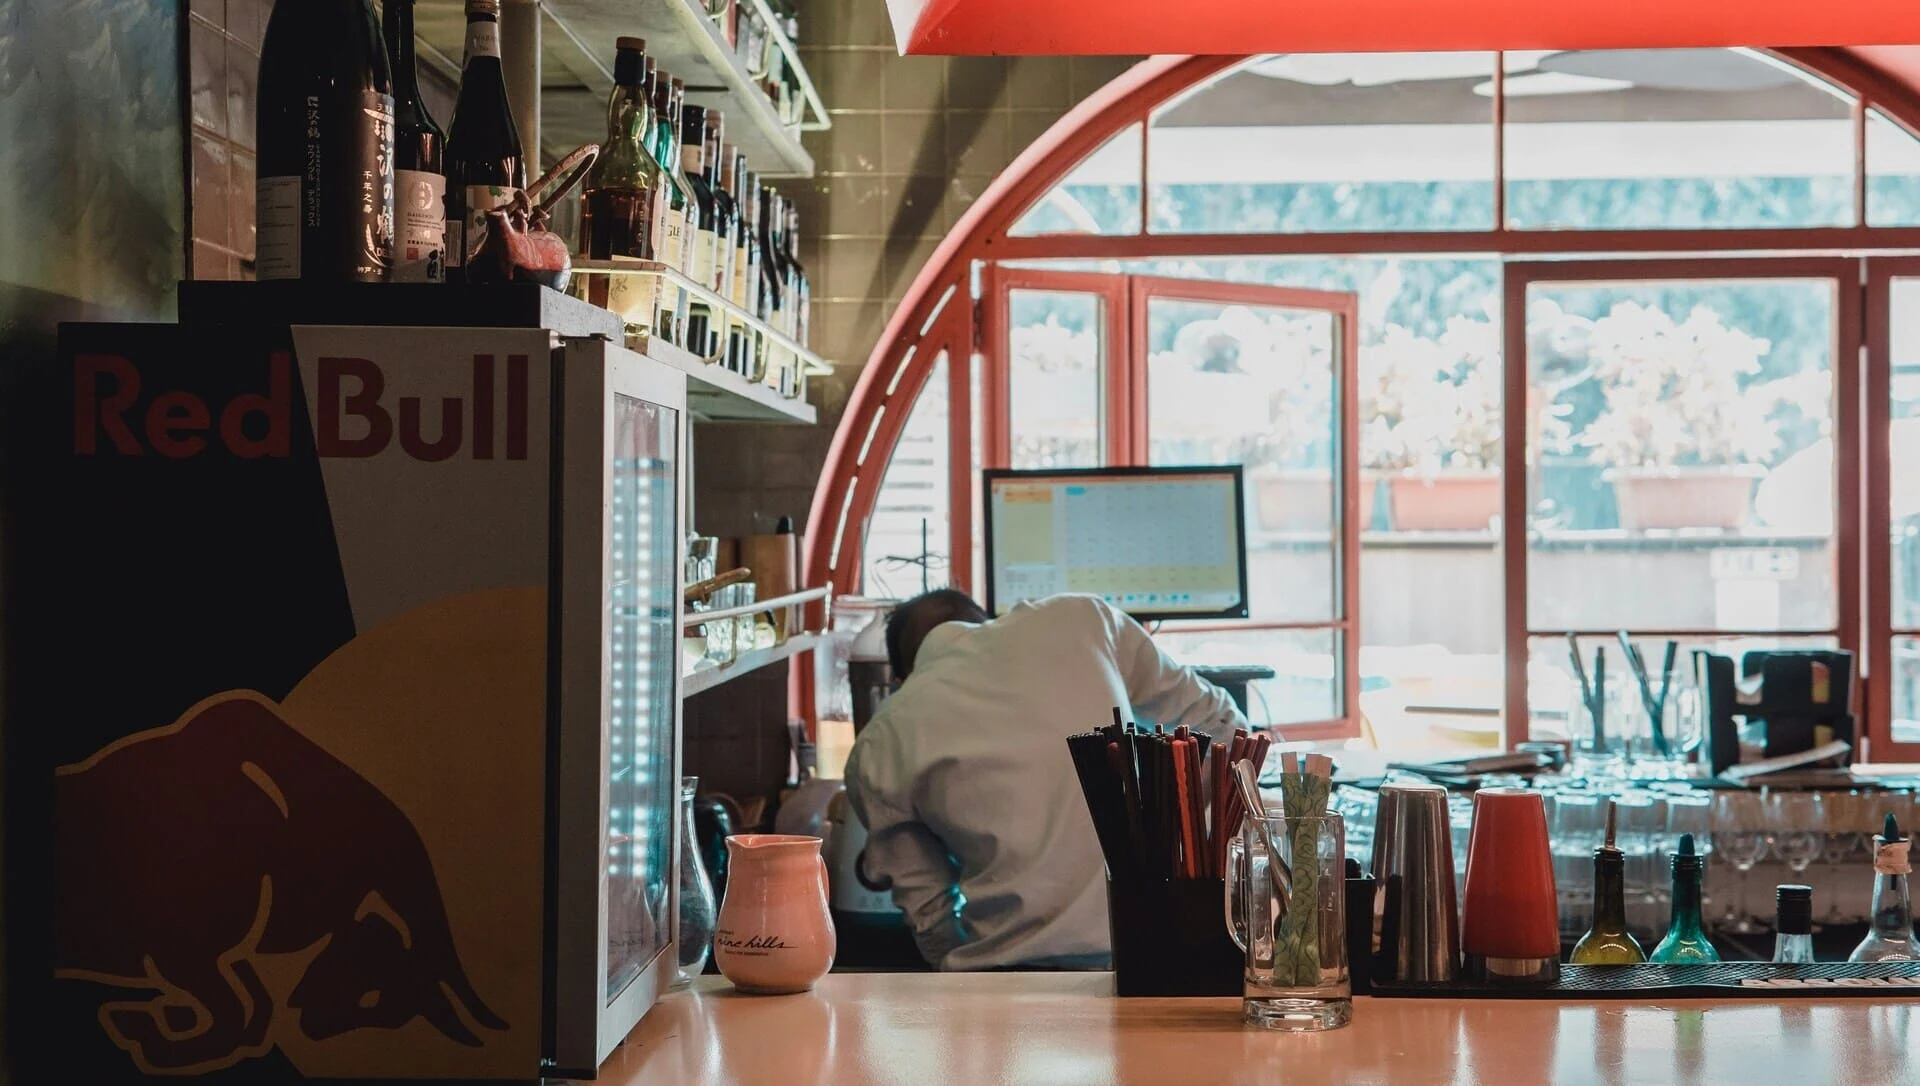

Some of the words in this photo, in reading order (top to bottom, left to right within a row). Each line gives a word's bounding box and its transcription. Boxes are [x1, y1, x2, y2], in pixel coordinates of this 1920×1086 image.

[74, 352, 290, 459] Red
[318, 354, 528, 462] Bull
[743, 934, 799, 949] hills
